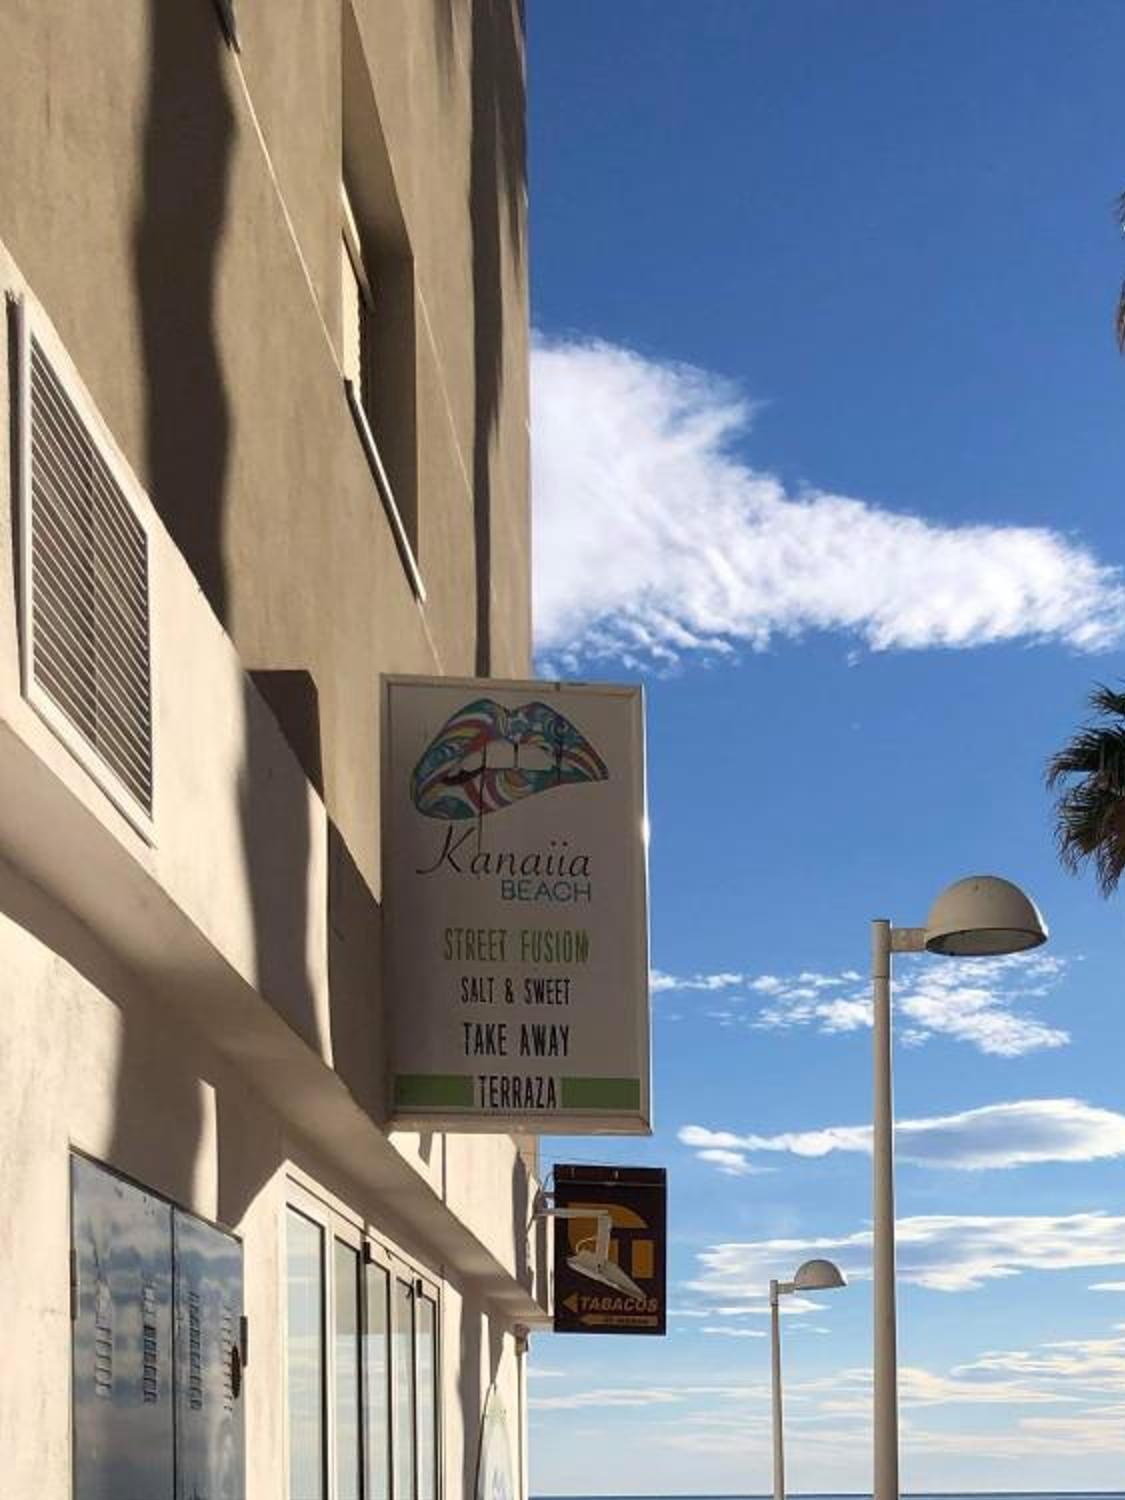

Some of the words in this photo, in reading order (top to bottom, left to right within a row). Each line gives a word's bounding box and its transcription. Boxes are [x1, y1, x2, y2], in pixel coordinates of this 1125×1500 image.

[501, 879, 592, 902] BEACH
[445, 928, 507, 961] STREET
[521, 930, 590, 964] FUSION
[461, 977, 494, 1003] SALT
[505, 978, 514, 1003] &
[524, 978, 571, 1005] SWEET
[463, 1022, 508, 1056] TAKE
[520, 1024, 570, 1057] AWAY
[478, 1076, 557, 1108] TERRAZA
[578, 1297, 658, 1313] TABACOS
